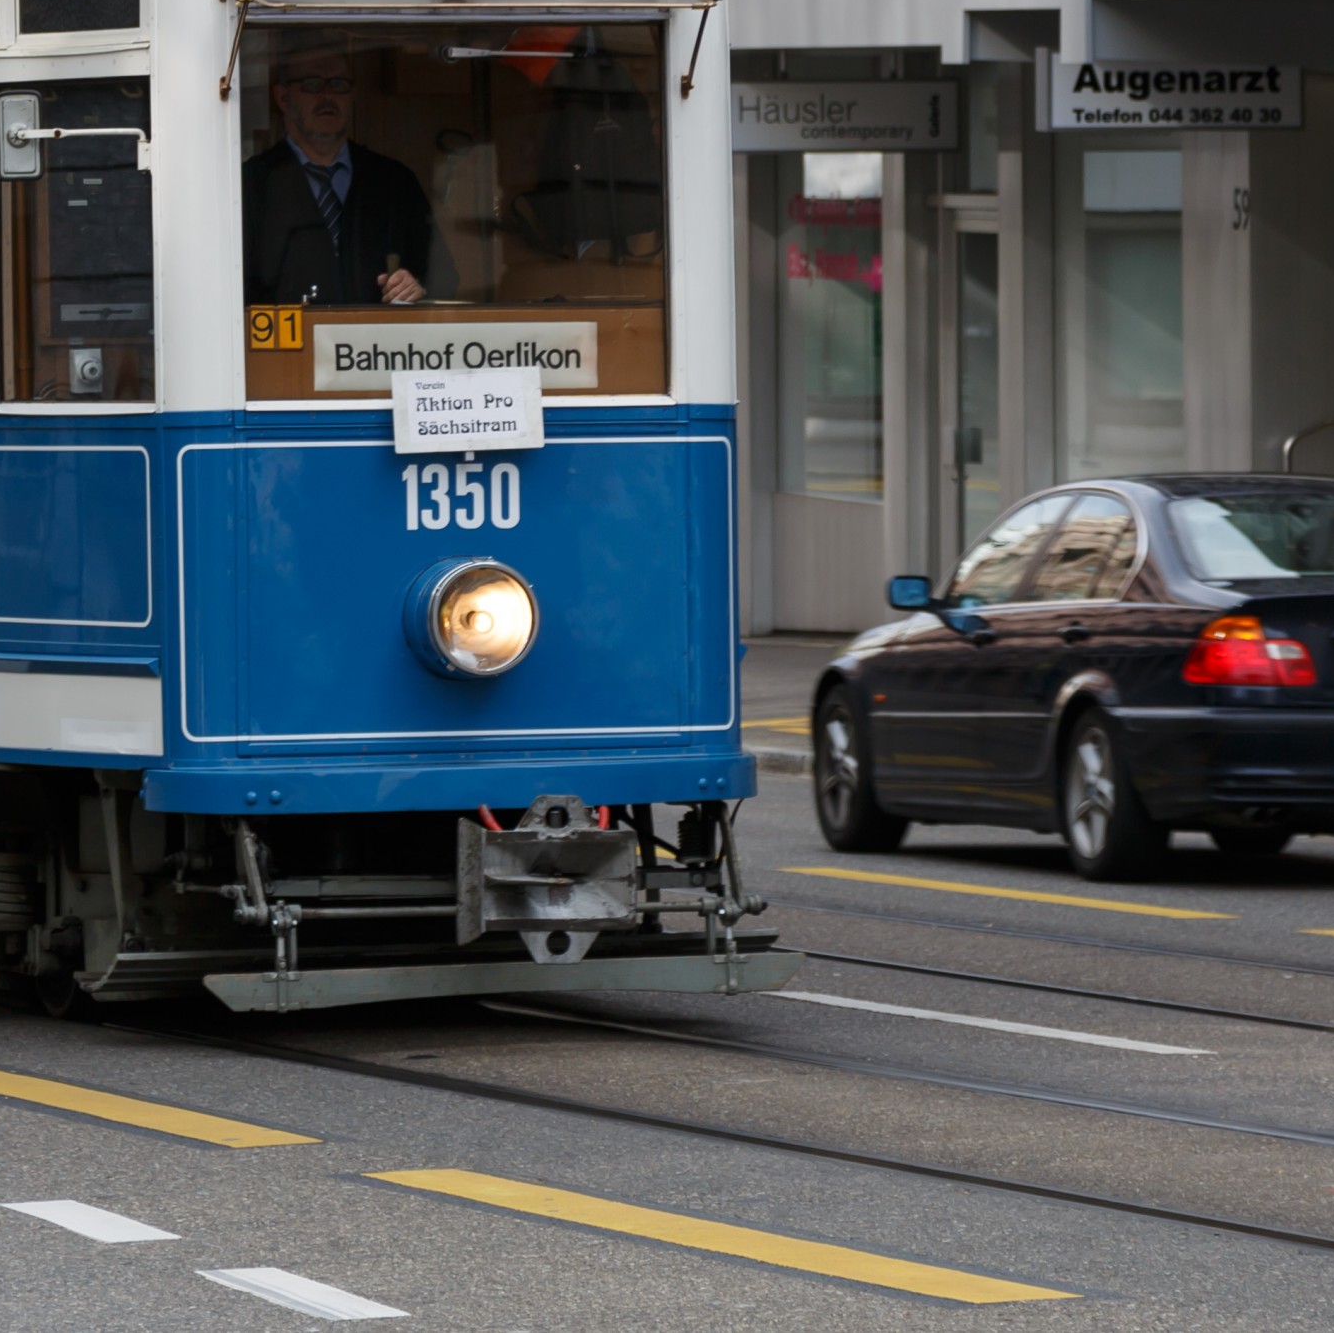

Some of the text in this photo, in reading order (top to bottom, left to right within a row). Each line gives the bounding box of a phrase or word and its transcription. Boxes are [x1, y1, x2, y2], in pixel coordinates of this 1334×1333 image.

[1073, 64, 1281, 101] Augenarzt
[738, 93, 858, 125] Häusler
[1073, 108, 1282, 124] Telefon 044 362 40 30
[800, 124, 915, 142] contemporary
[1233, 187, 1249, 231] 59
[251, 312, 297, 344] 91
[335, 342, 581, 372] Bahnhof Oerlikon
[415, 381, 445, 390] Verein
[416, 394, 513, 412] Aktion Pro
[417, 419, 517, 436] Sächsitram
[401, 462, 520, 531] 1350
